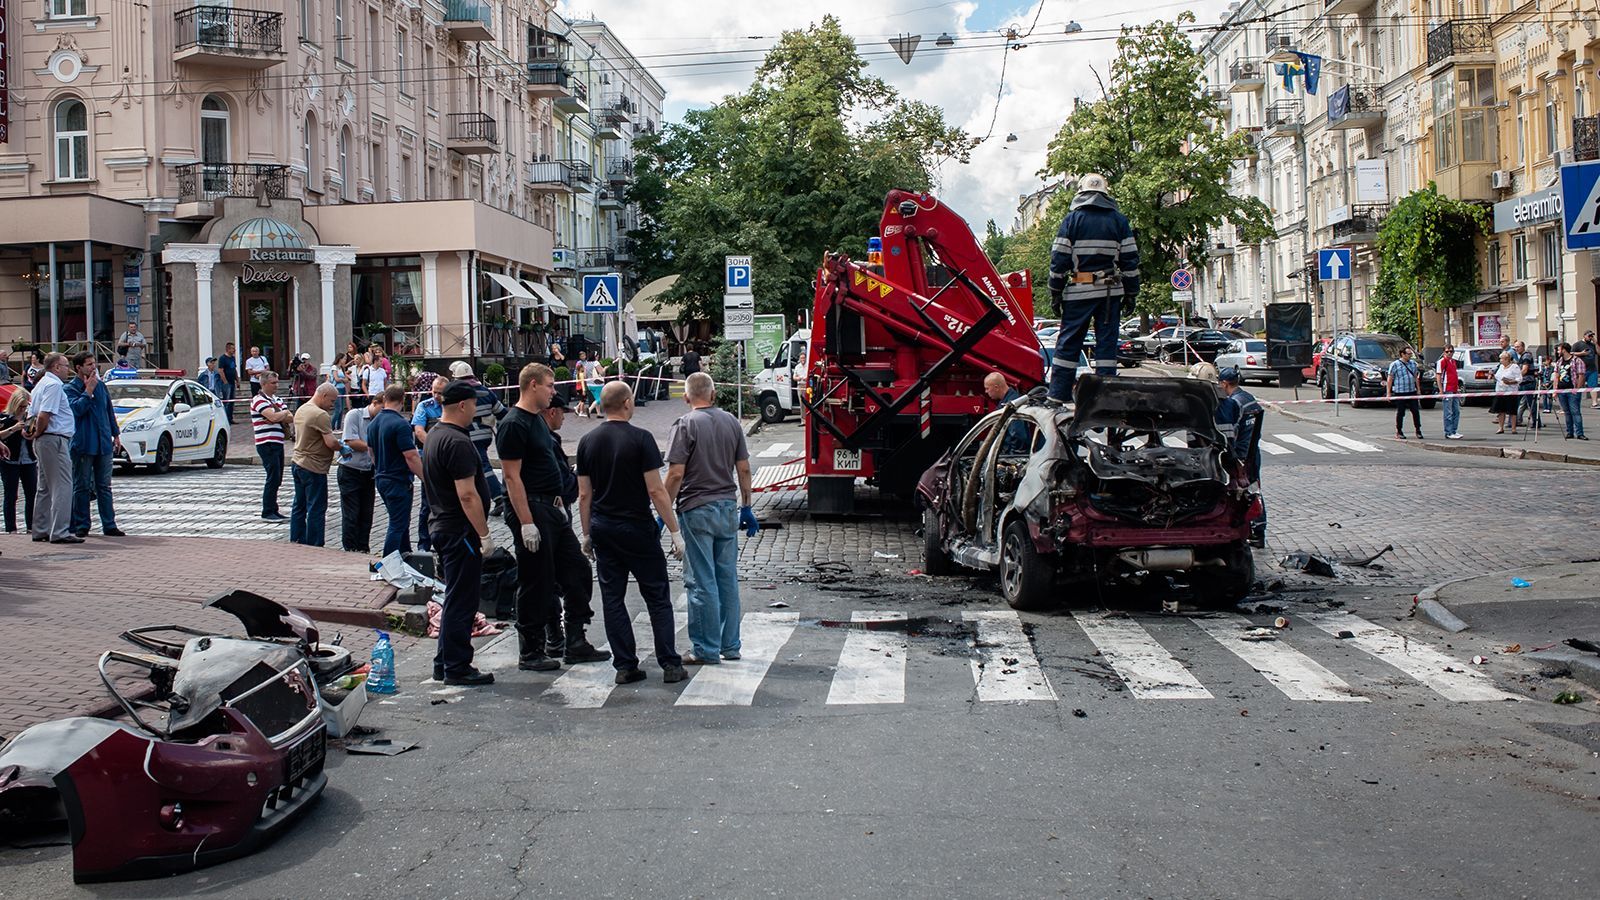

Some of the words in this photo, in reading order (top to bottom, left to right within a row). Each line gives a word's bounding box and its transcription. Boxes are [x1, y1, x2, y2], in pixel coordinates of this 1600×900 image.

[1513, 192, 1561, 223] elenamiro
[242, 263, 289, 284] Device
[734, 268, 746, 285] P
[981, 276, 998, 296] AMCO
[837, 460, 858, 468] КИП
